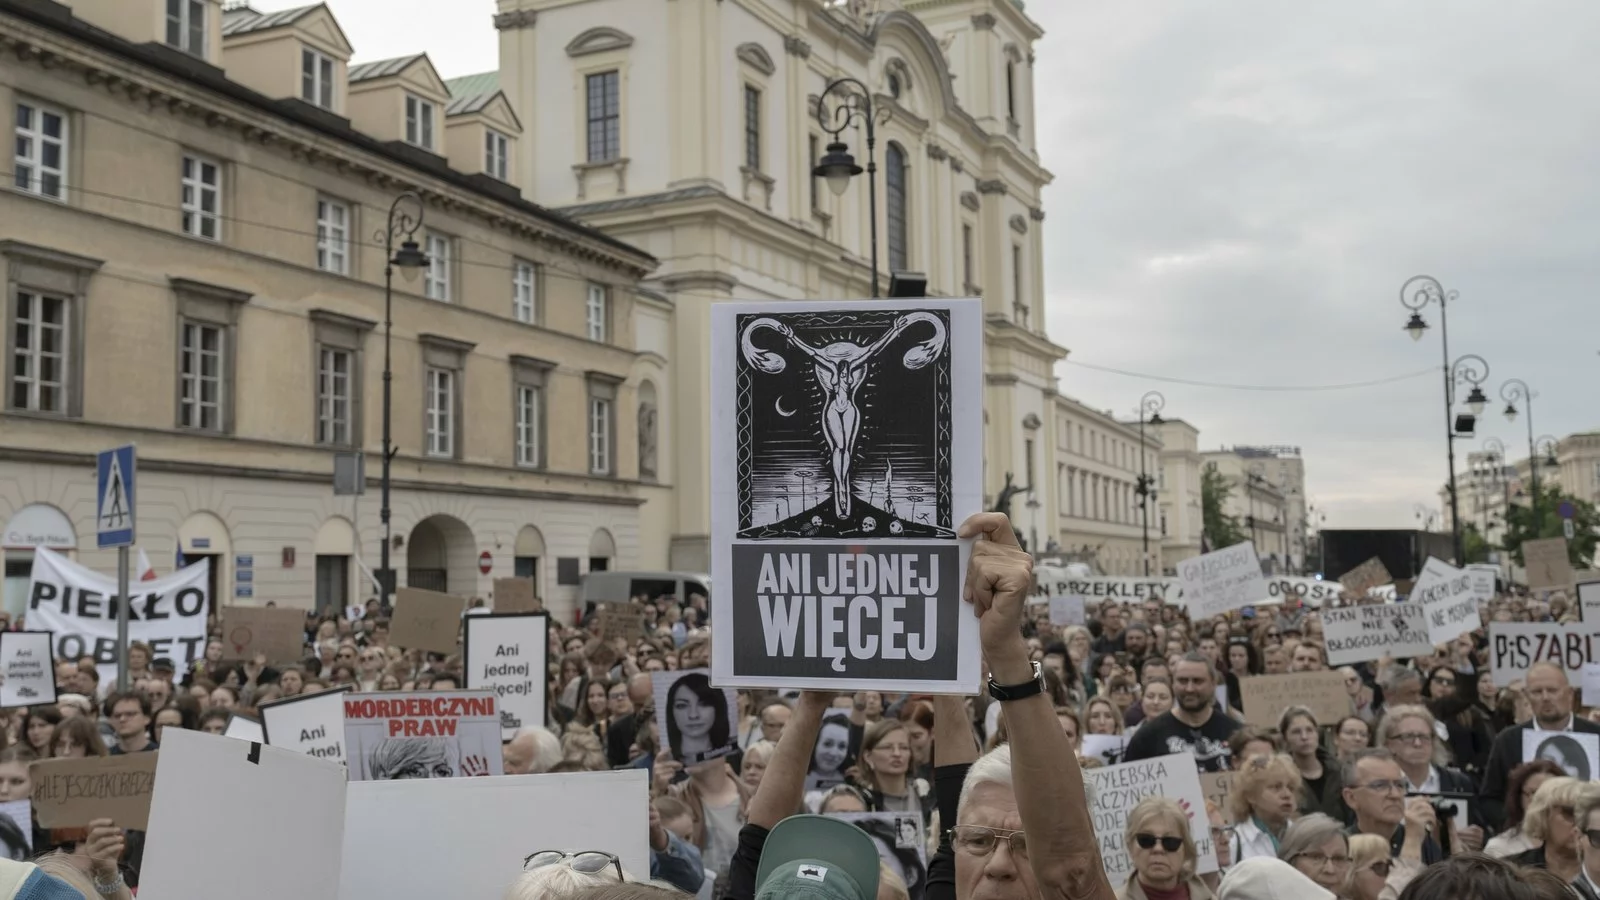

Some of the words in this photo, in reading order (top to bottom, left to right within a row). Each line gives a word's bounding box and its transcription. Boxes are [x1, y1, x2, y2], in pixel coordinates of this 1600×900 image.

[757, 553, 811, 594] ANI
[817, 553, 939, 595] JEDNEJ
[31, 582, 204, 620] PIEKŁO
[1324, 608, 1357, 624] STAN
[1362, 619, 1386, 630] NIE
[757, 596, 938, 672] WIĘCEJ
[57, 634, 203, 664] OBET
[495, 644, 519, 657] Ani
[484, 662, 529, 679] jednej
[344, 697, 495, 719] MORDERCZYNI
[300, 724, 326, 742] Ani
[389, 719, 457, 737] PRAW
[306, 741, 341, 758] dnej
[1090, 762, 1168, 790] ZYŁEBSKA
[1092, 783, 1164, 811] ACZYŃSKI
